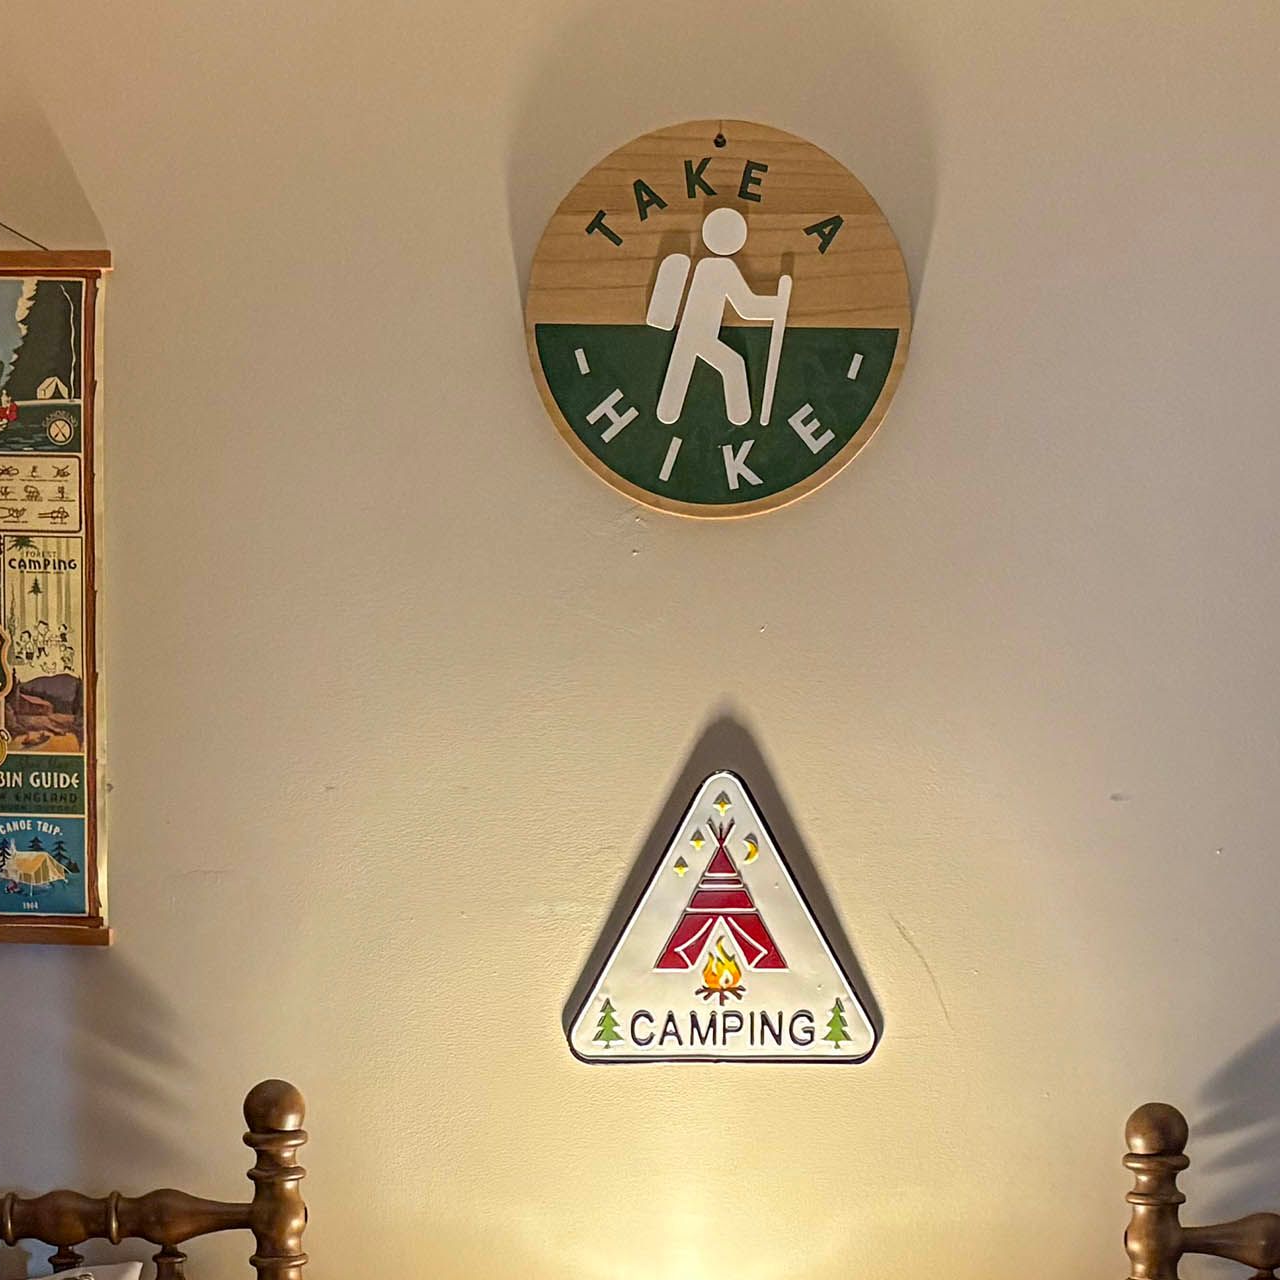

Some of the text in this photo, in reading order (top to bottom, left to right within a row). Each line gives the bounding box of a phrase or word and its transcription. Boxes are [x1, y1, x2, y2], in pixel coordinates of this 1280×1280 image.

[585, 157, 844, 254] TAKE A
[585, 388, 836, 490] HIKE
[8, 558, 78, 570] CAMPING
[29, 771, 80, 789] GUIDE
[36, 821, 61, 836] TRIP
[630, 1009, 816, 1047] CAMPING
